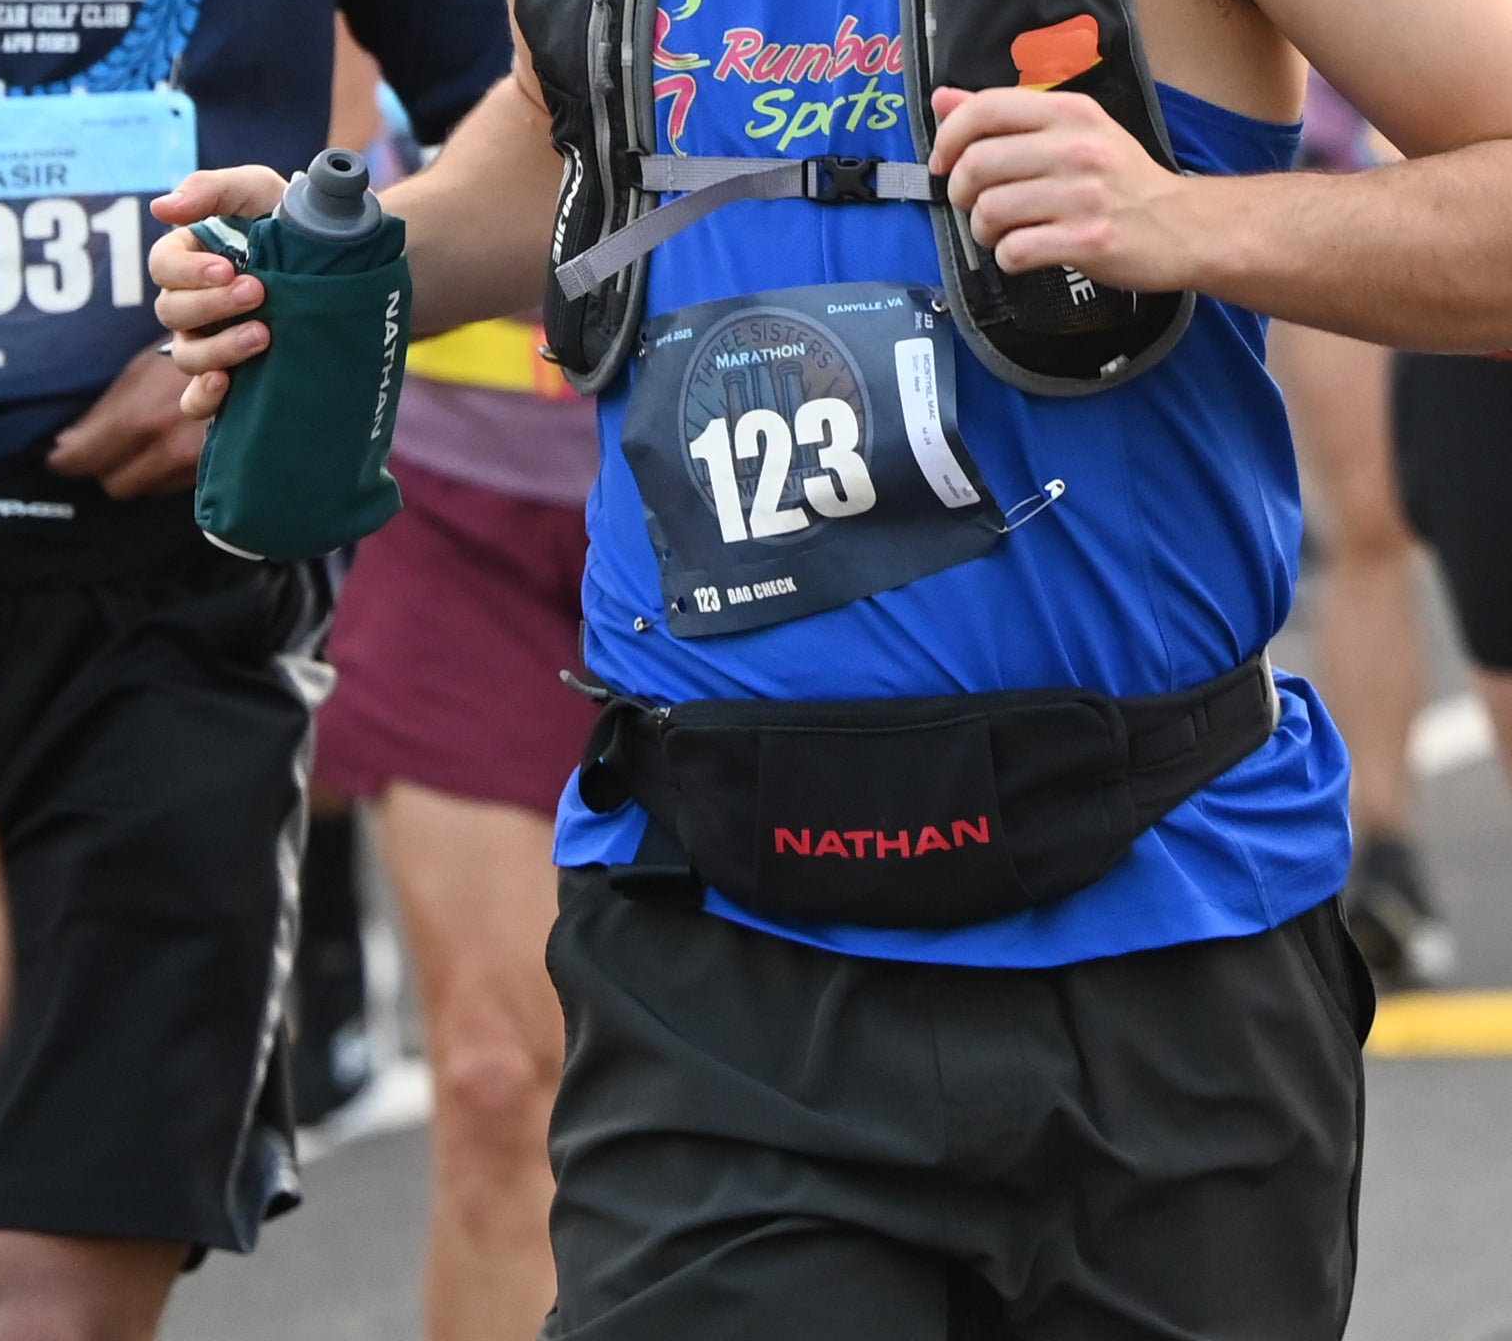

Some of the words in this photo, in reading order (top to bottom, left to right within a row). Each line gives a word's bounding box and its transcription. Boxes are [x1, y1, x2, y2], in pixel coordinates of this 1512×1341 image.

[827, 301, 882, 315] DANVILLE
[370, 290, 400, 440] NATHAN
[715, 342, 806, 370] MARATHON
[689, 397, 878, 544] 123
[693, 585, 722, 613] 123
[726, 587, 754, 606] BAG
[753, 576, 798, 601] CHECK
[774, 815, 991, 861] NATHAN
